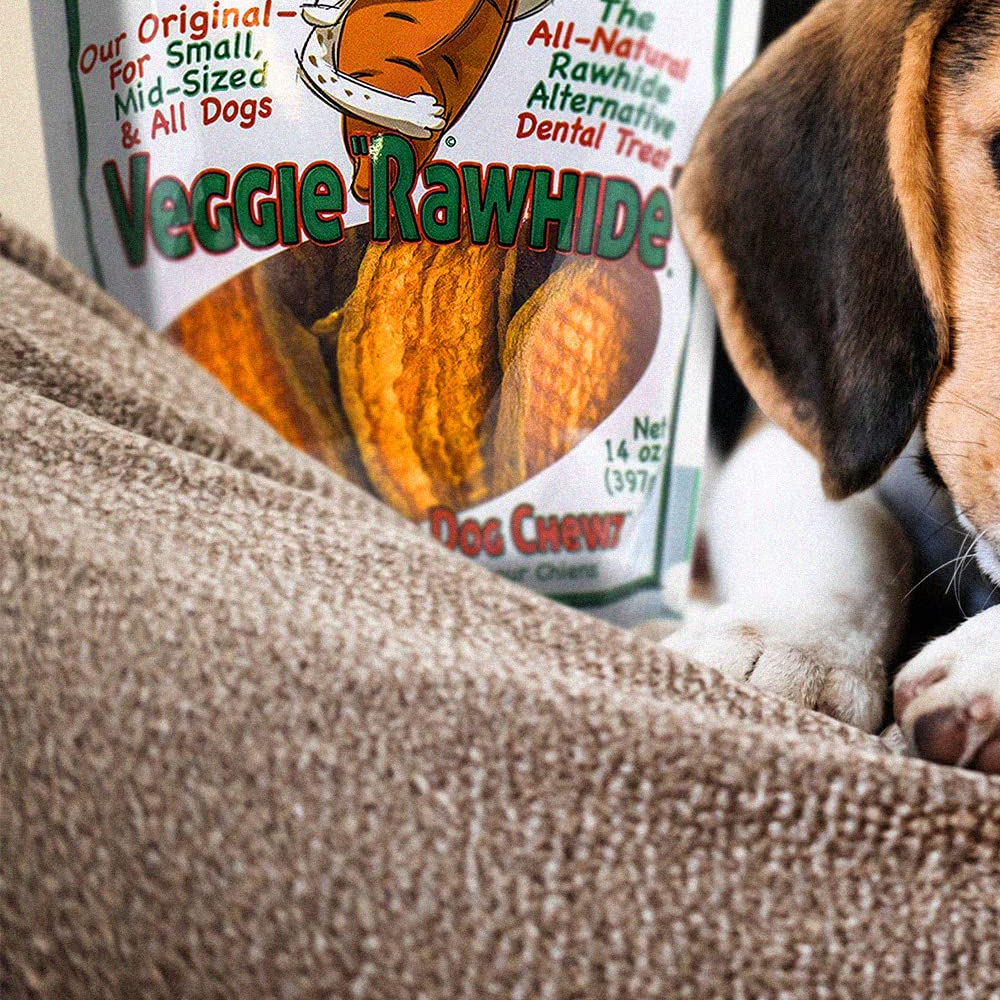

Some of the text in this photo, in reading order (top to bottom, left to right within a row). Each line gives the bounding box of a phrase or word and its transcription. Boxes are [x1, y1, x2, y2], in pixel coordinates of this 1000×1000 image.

[79, 32, 128, 75] Our
[109, 29, 263, 90] For Small,
[527, 20, 691, 83] All-Natural
[548, 51, 671, 105] Rawhide
[114, 60, 269, 121] Mid-Sized
[526, 80, 675, 140] Alternative
[120, 96, 274, 149] & All Dogs
[516, 112, 608, 150] Dental
[605, 438, 662, 463] 14 oz
